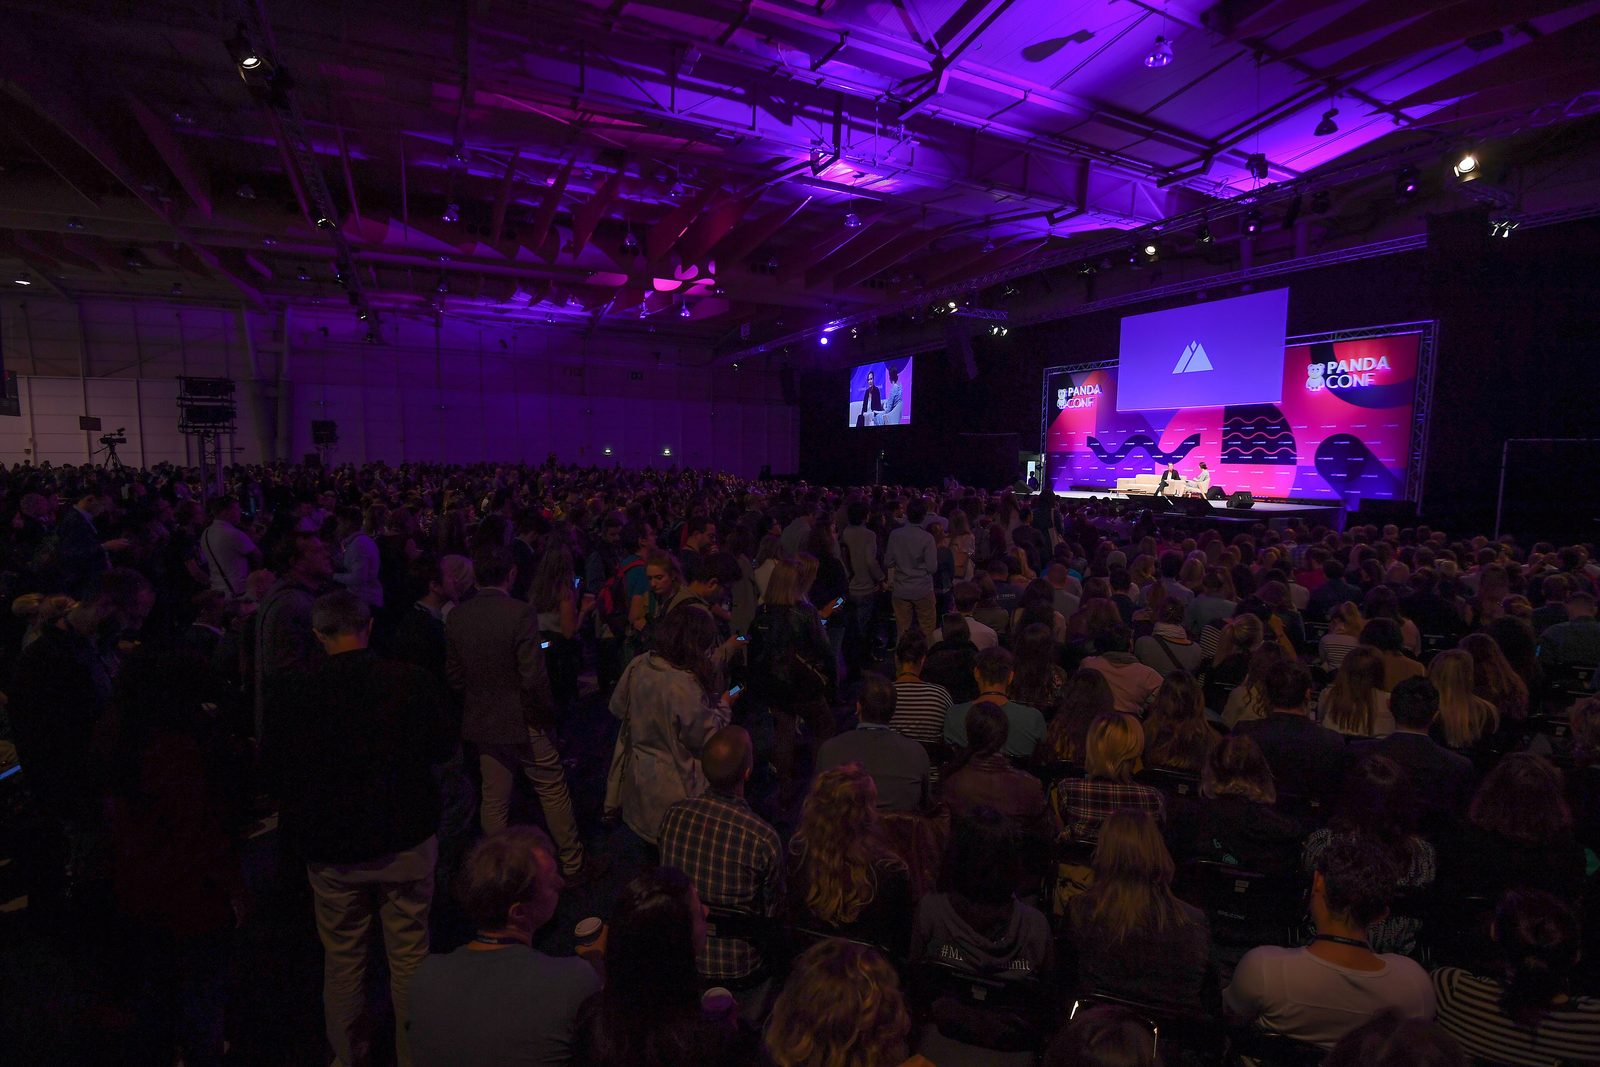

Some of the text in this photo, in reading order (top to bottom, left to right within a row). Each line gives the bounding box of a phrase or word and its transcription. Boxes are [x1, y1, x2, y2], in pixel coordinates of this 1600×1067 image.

[1327, 356, 1392, 375] PANDA
[1326, 373, 1377, 389] CONF
[1068, 384, 1102, 397] PANDA
[1067, 397, 1094, 408] CONF
